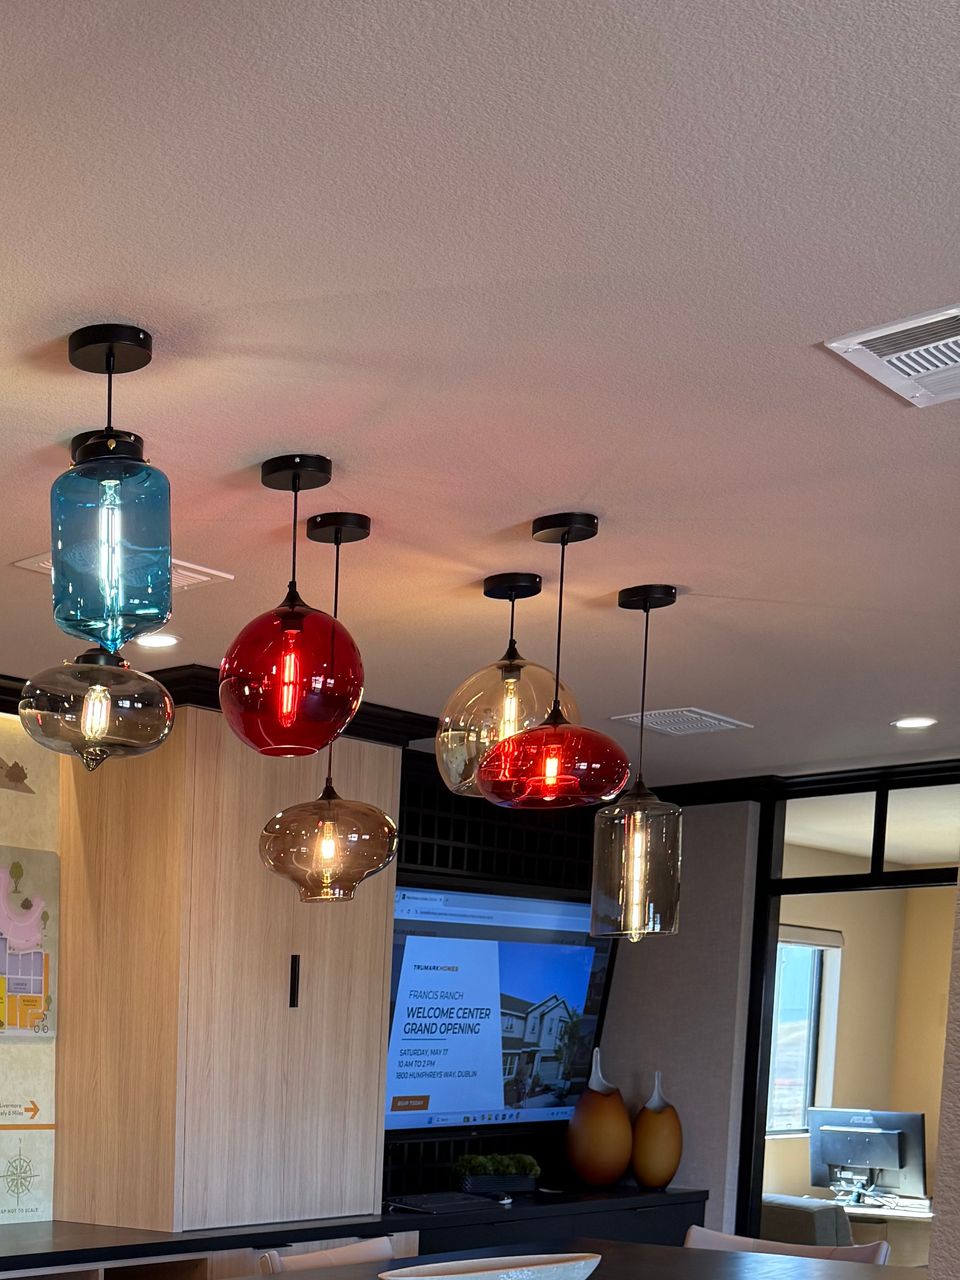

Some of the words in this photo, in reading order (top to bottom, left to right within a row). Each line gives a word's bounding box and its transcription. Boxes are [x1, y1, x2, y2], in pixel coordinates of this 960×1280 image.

[409, 989, 438, 1000] FRANCIS
[439, 990, 464, 1000] RANCH
[406, 1006, 455, 1019] WELCOME
[456, 1007, 491, 1019] CENTER
[403, 1022, 438, 1034] GRAND
[439, 1022, 481, 1034] OPENING
[399, 1048, 429, 1056] SATURDAY,
[430, 1048, 442, 1056] MAY
[398, 1060, 404, 1068] 10
[457, 1070, 478, 1078] DUBLIN
